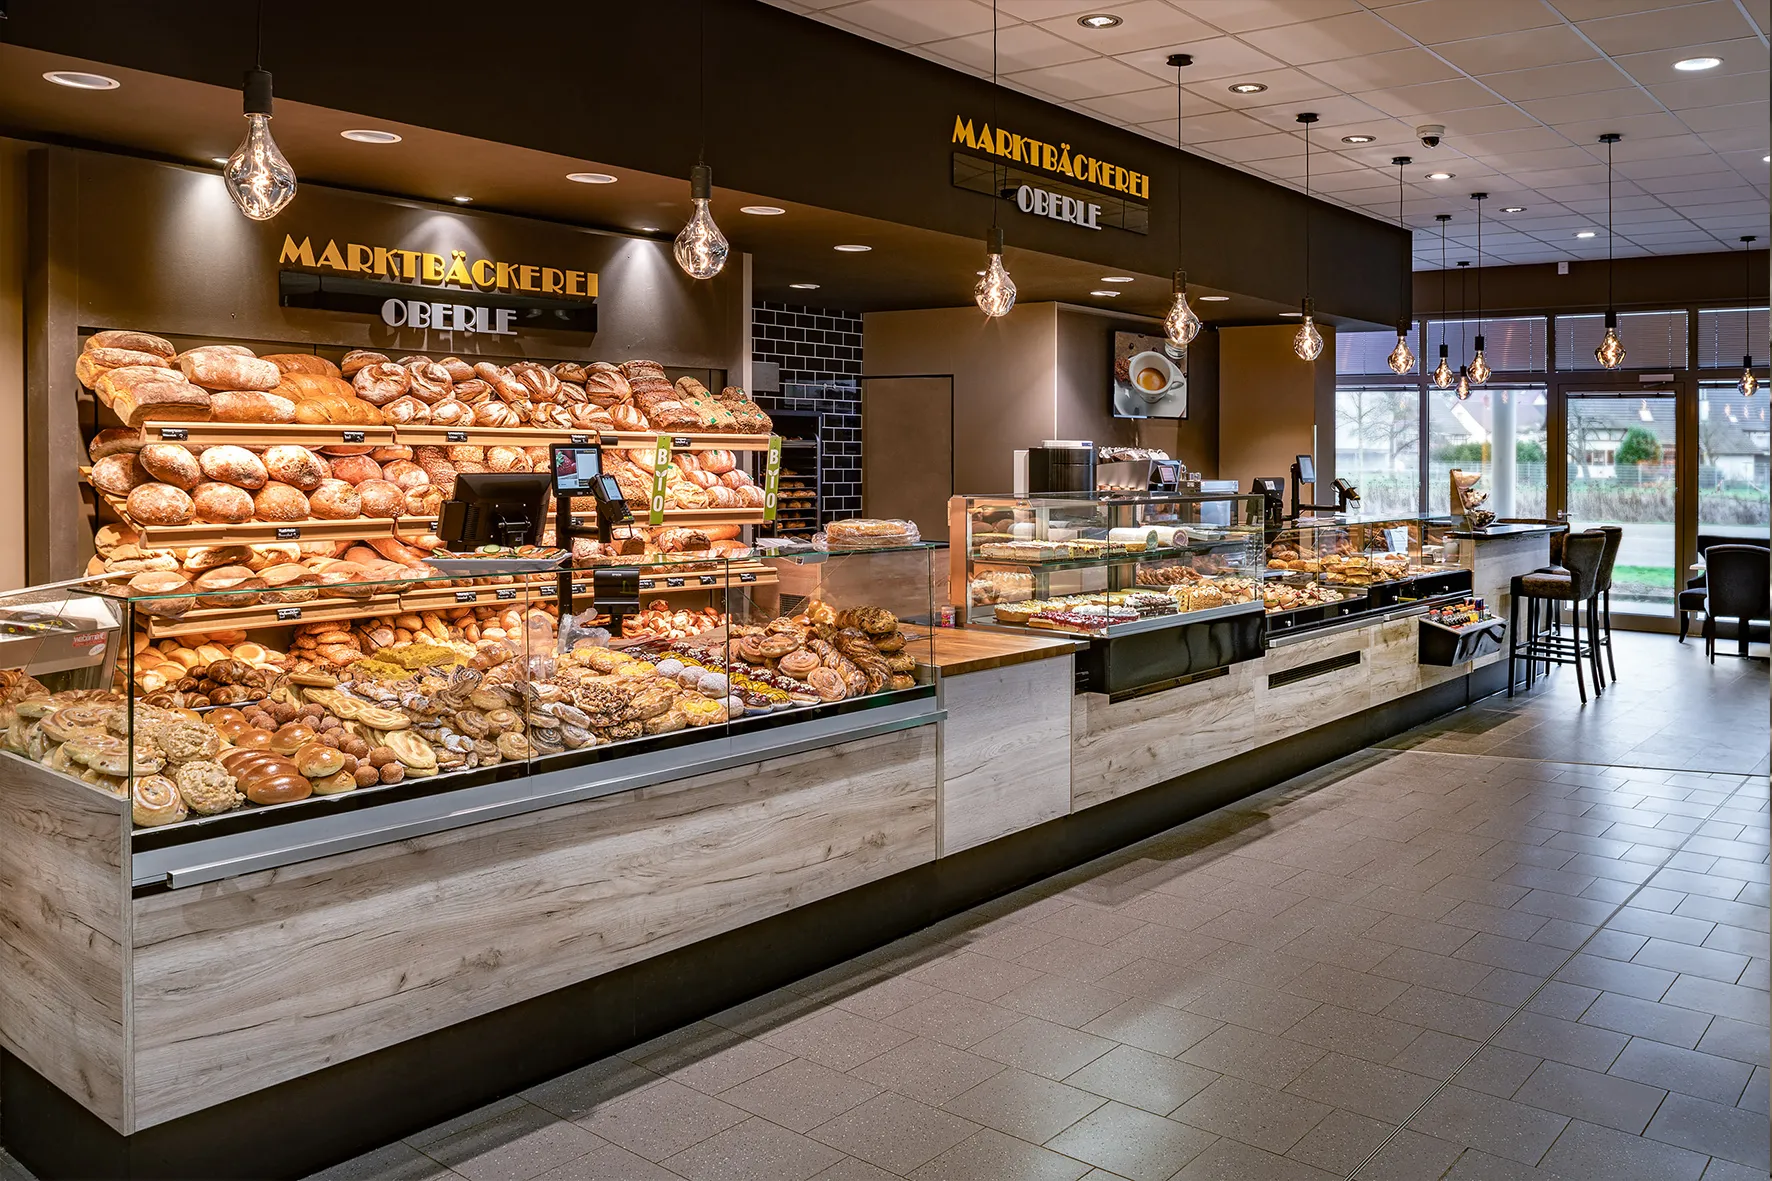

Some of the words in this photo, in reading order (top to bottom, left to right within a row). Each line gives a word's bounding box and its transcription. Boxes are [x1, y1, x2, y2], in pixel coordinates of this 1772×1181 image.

[952, 115, 1149, 199] MARKTBÄCKEREI
[1017, 185, 1102, 230] OBERLE
[278, 233, 598, 297] MARKTBÄCKEREI
[381, 298, 518, 335] OBERLE
[653, 448, 668, 512] BIO
[766, 449, 779, 509] BIO
